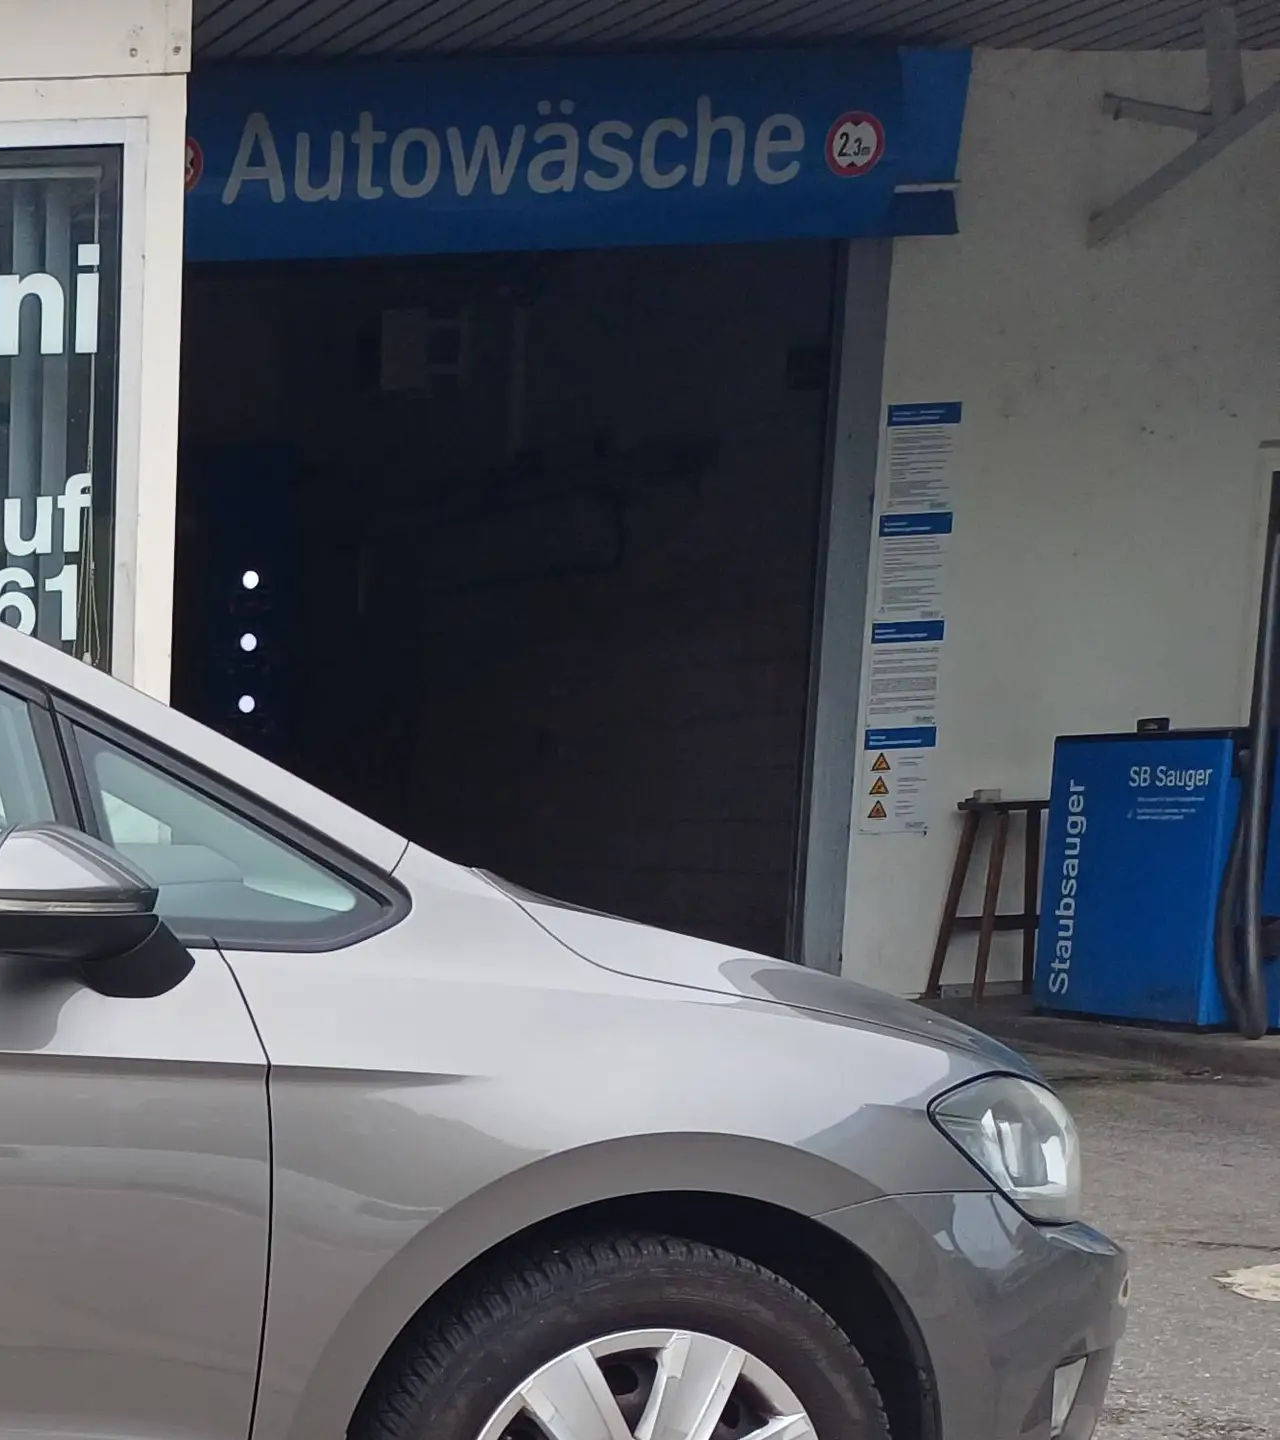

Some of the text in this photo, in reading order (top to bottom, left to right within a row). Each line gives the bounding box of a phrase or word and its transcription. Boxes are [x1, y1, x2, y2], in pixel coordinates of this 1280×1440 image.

[221, 94, 805, 205] Autowäsche
[1128, 765, 1214, 791] SB Sauger
[1048, 779, 1087, 995] Staubsauger
